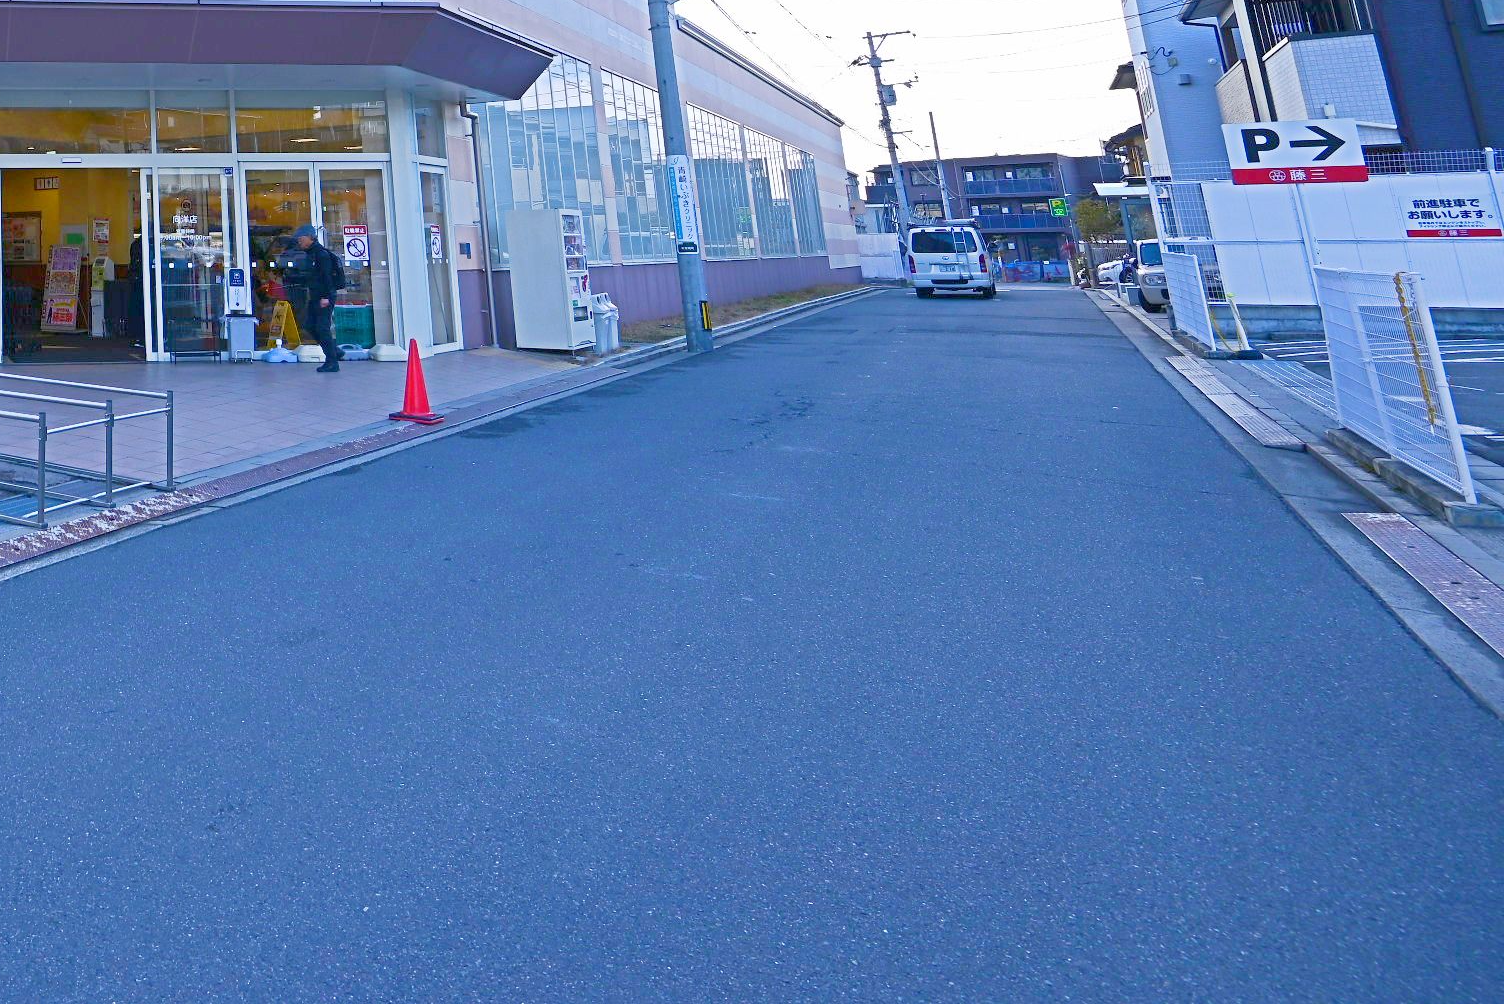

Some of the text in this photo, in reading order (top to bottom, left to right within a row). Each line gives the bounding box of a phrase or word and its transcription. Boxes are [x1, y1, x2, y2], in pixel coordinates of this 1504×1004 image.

[1241, 128, 1280, 163] P
[1289, 168, 1328, 181] 藤三
[1412, 199, 1480, 209] 前進駐車で
[1407, 209, 1494, 220] お願いします。
